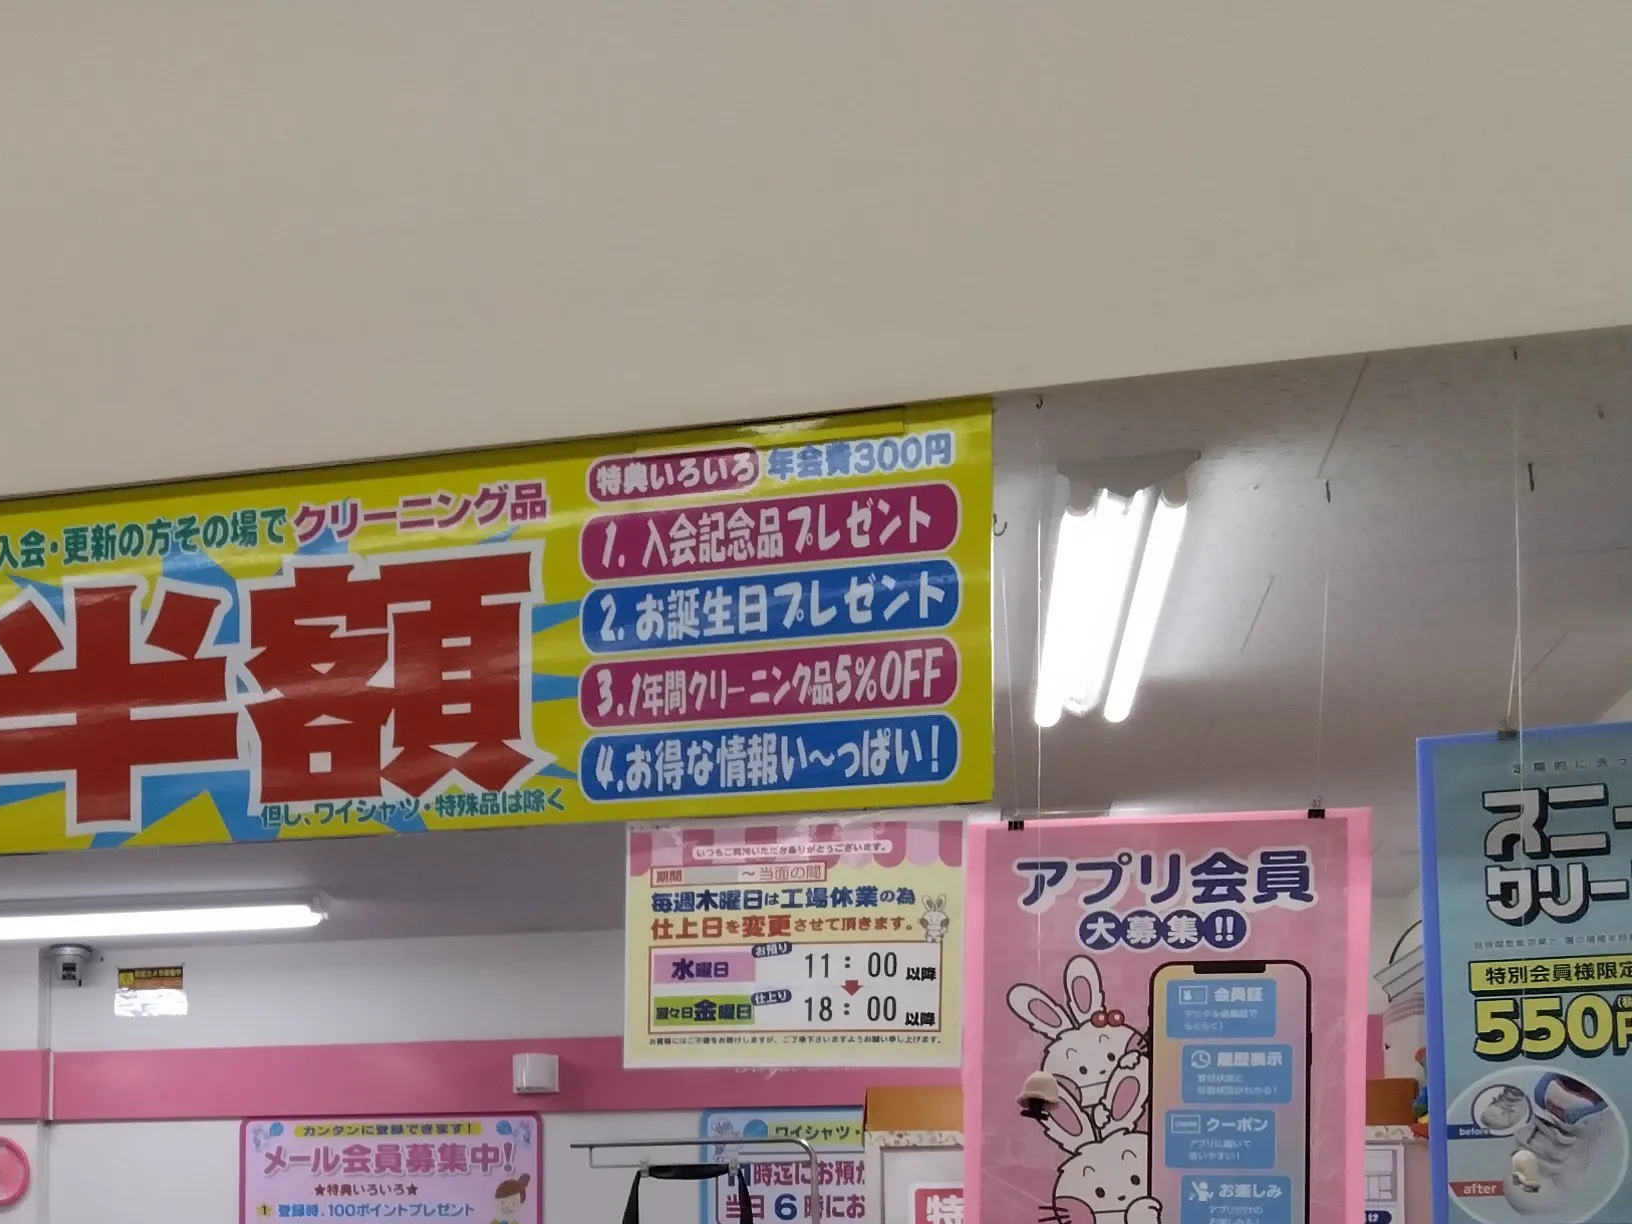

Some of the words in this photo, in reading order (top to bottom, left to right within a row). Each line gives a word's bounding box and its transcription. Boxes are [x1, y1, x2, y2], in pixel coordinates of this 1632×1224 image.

[596, 449, 755, 497] 特典いろいろ
[768, 432, 952, 480] 年会費300円
[1482, 783, 1632, 859] スニ
[1017, 850, 1314, 906] アプリ会員
[651, 886, 916, 912] 毎週木曜日は工場休業の為
[651, 915, 913, 940] 仕上日を変更させて頂きます。
[671, 958, 729, 980] 水曜日
[906, 967, 936, 982] 以降
[905, 1012, 936, 1026] 以降
[1207, 1117, 1268, 1132] クーポン
[264, 1142, 514, 1176] メール会員募集中!
[1464, 1184, 1497, 1195] after
